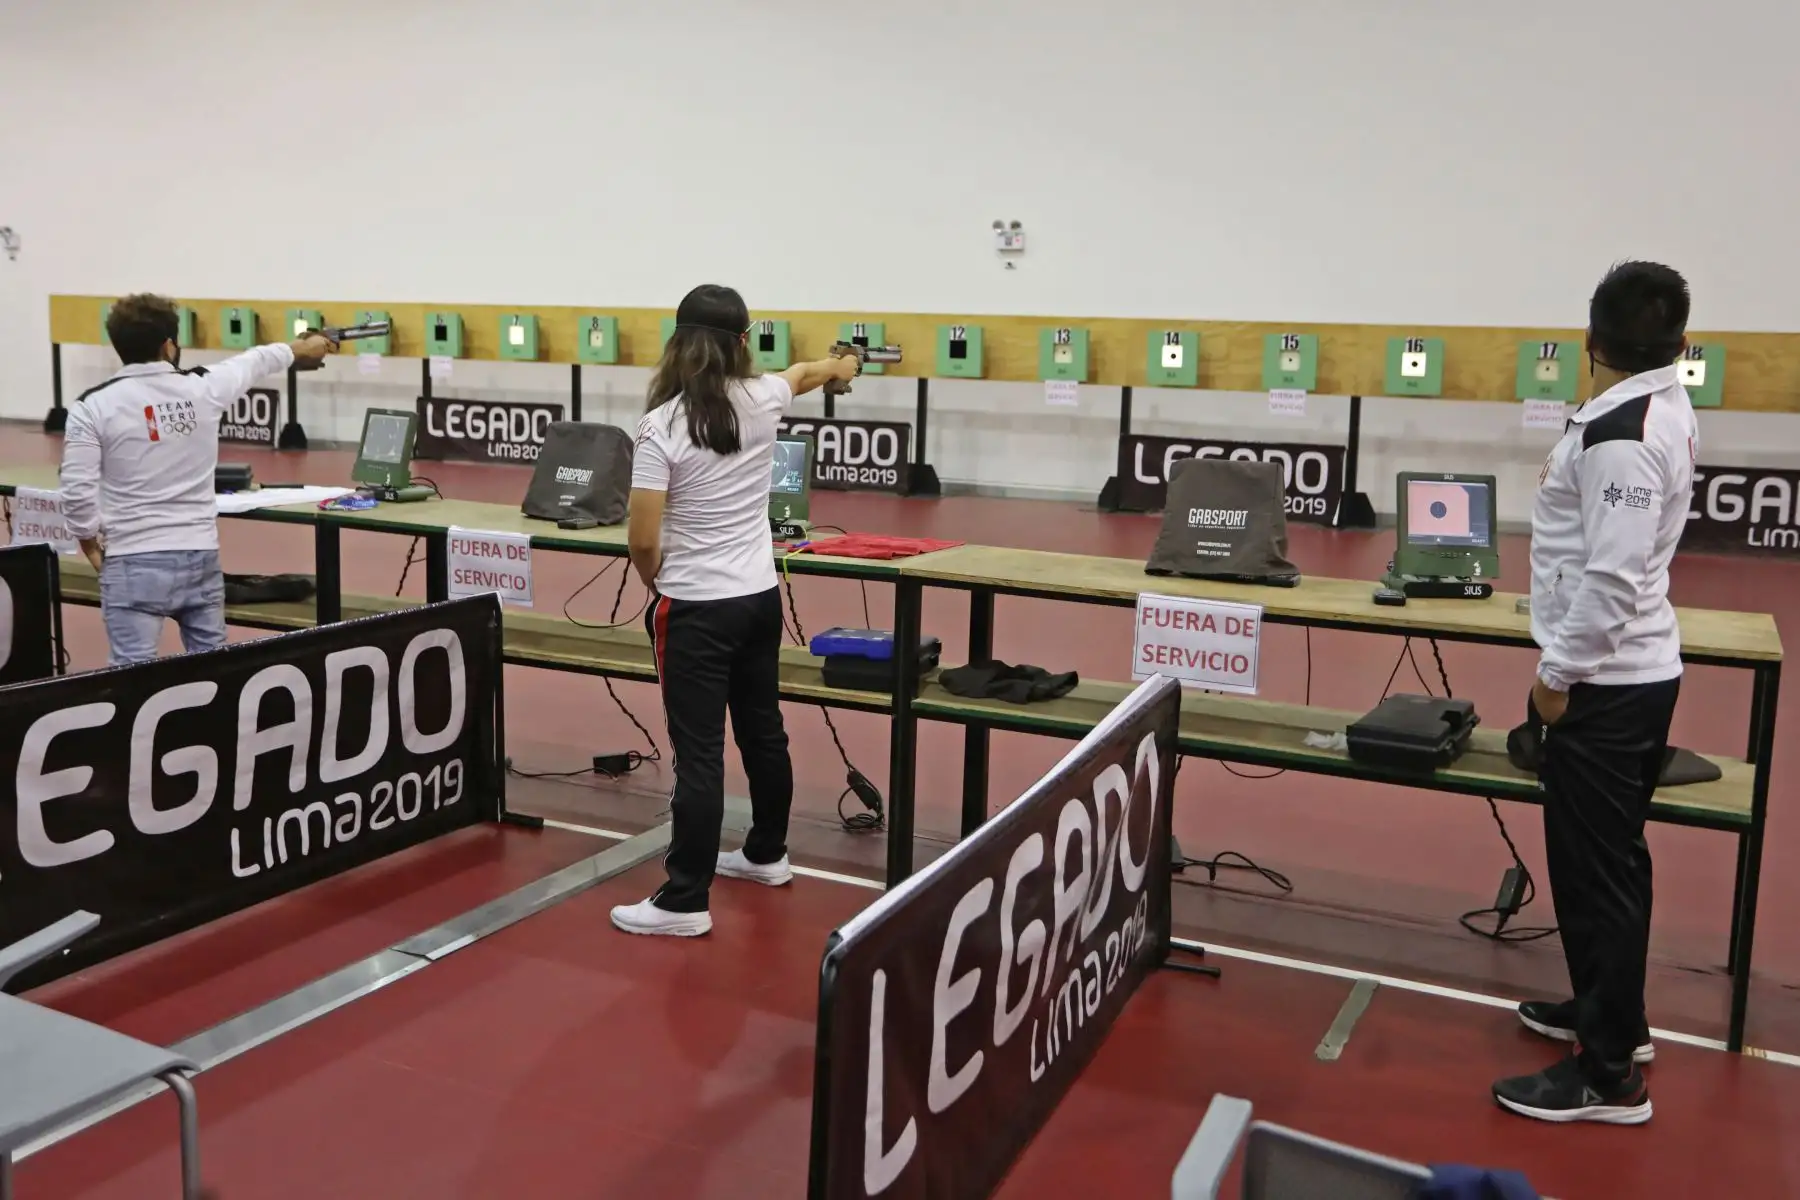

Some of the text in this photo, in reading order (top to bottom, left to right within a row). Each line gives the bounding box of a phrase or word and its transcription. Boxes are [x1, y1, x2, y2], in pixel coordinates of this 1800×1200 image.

[760, 320, 773, 334] 10
[853, 322, 866, 337] 11
[951, 326, 965, 341] 12
[1056, 329, 1070, 344] 13
[1164, 331, 1179, 346] 14
[1282, 334, 1299, 350] 15
[1405, 337, 1422, 353] 16
[1541, 341, 1558, 358] 17
[1684, 345, 1703, 361] 18
[156, 400, 193, 412] TEAM
[160, 411, 196, 424] PERU
[426, 402, 553, 444] LEGADO
[219, 423, 245, 439] ima
[555, 466, 594, 483] GABSPORT
[18, 496, 57, 514] FUERA
[1625, 494, 1651, 507] 2019
[1188, 508, 1248, 527] GABSPORT
[451, 539, 527, 562] FUERA DE
[454, 568, 526, 590] SERVICIO
[1463, 585, 1483, 596] SIUS
[1141, 606, 1256, 638] FUERA DE
[1141, 643, 1249, 674] SERVICIO
[16, 628, 467, 868] EGADO
[864, 731, 1160, 1197] LEGADO
